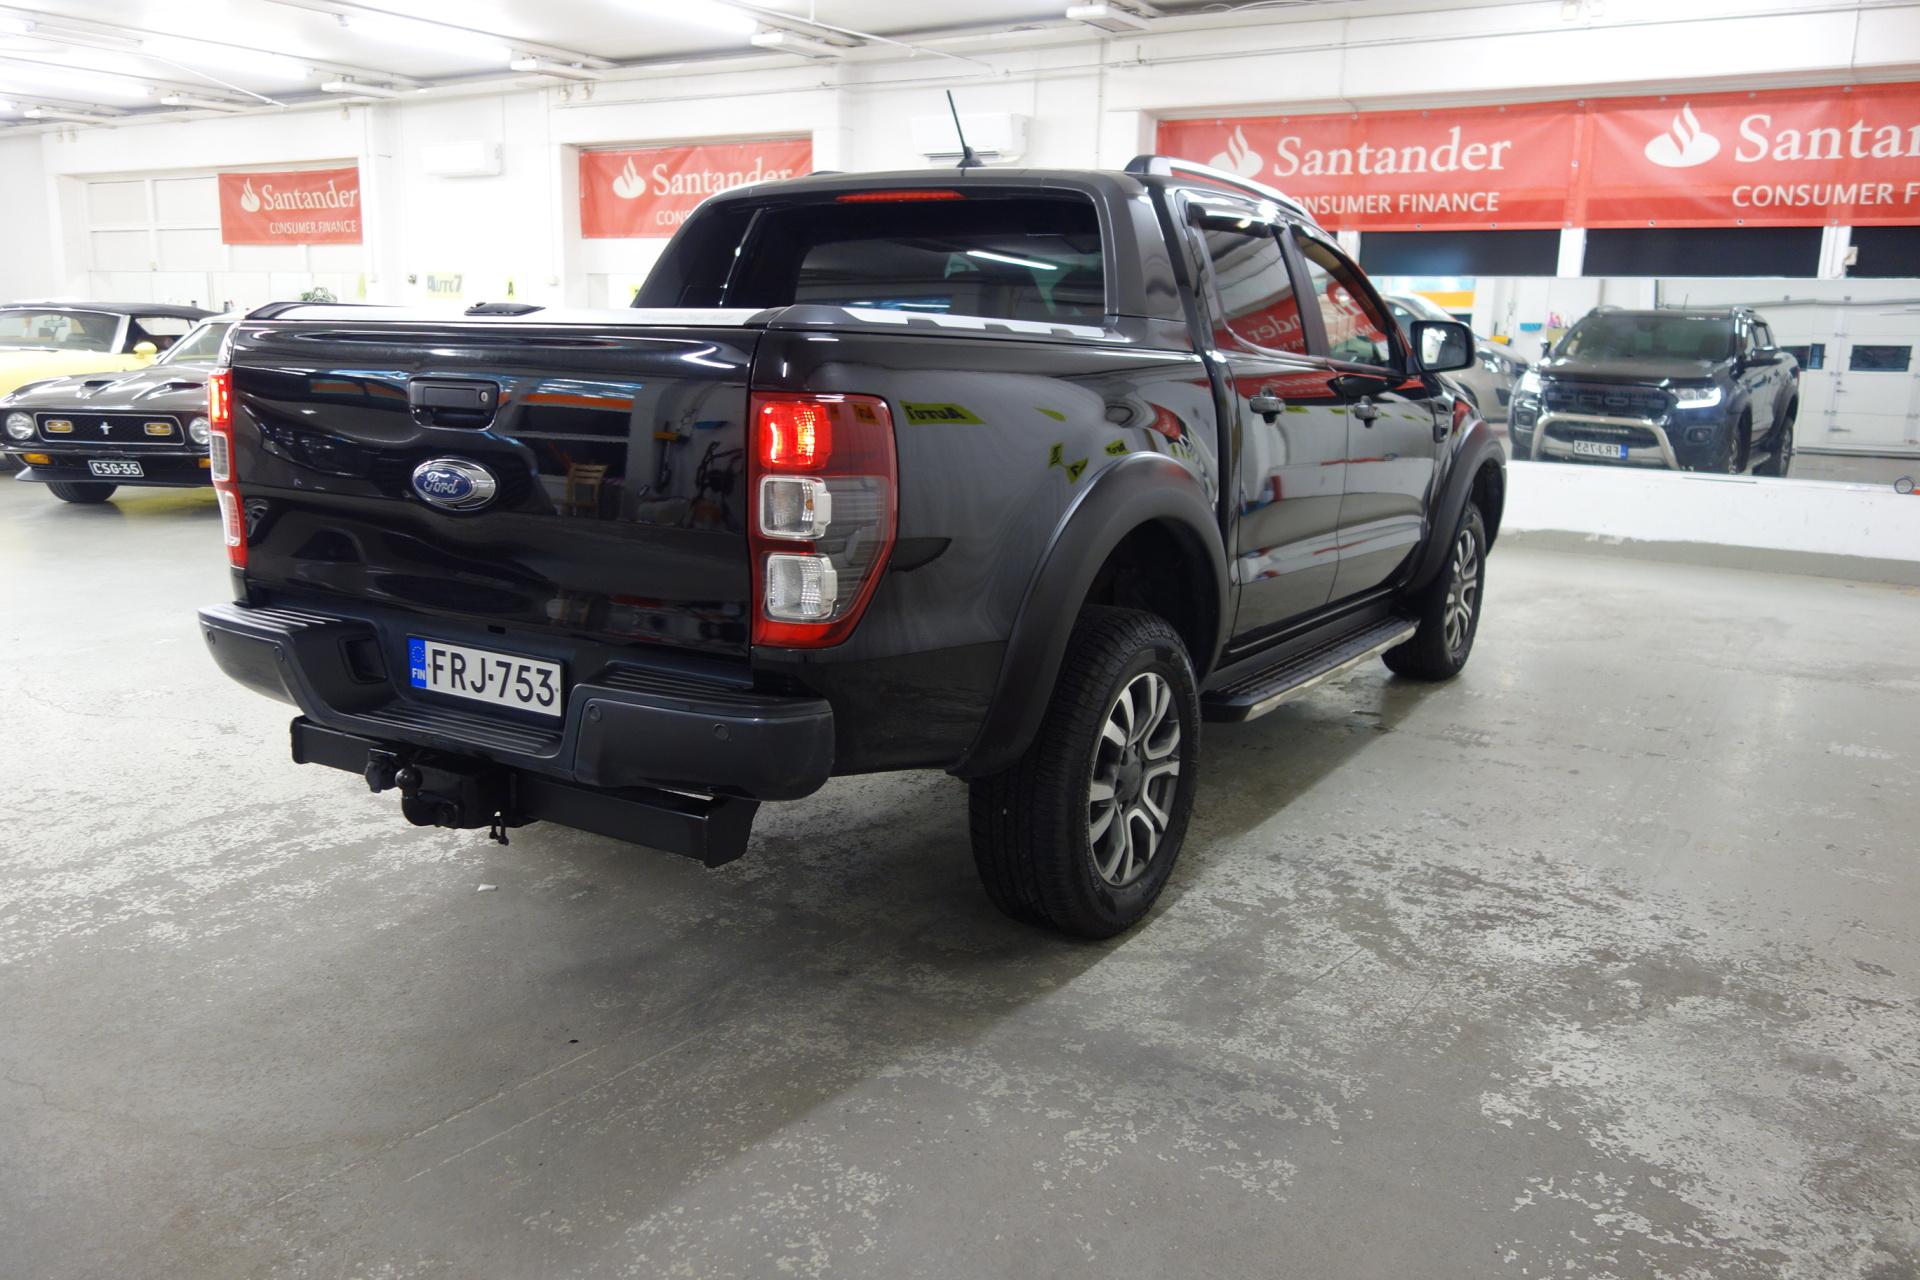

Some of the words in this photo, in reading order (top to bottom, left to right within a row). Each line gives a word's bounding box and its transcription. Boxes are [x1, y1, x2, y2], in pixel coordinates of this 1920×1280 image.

[1274, 126, 1511, 176] Santander
[261, 180, 358, 210] Santander
[1400, 192, 1499, 213] FINANCE
[1732, 183, 1893, 207] CONSUMER
[270, 220, 316, 234] CONSUMER
[319, 220, 357, 233] FINANCE
[92, 463, 139, 475] CSG-35
[424, 471, 458, 494] Ford
[412, 668, 426, 681] FIN
[432, 649, 554, 707] FRJ-753
